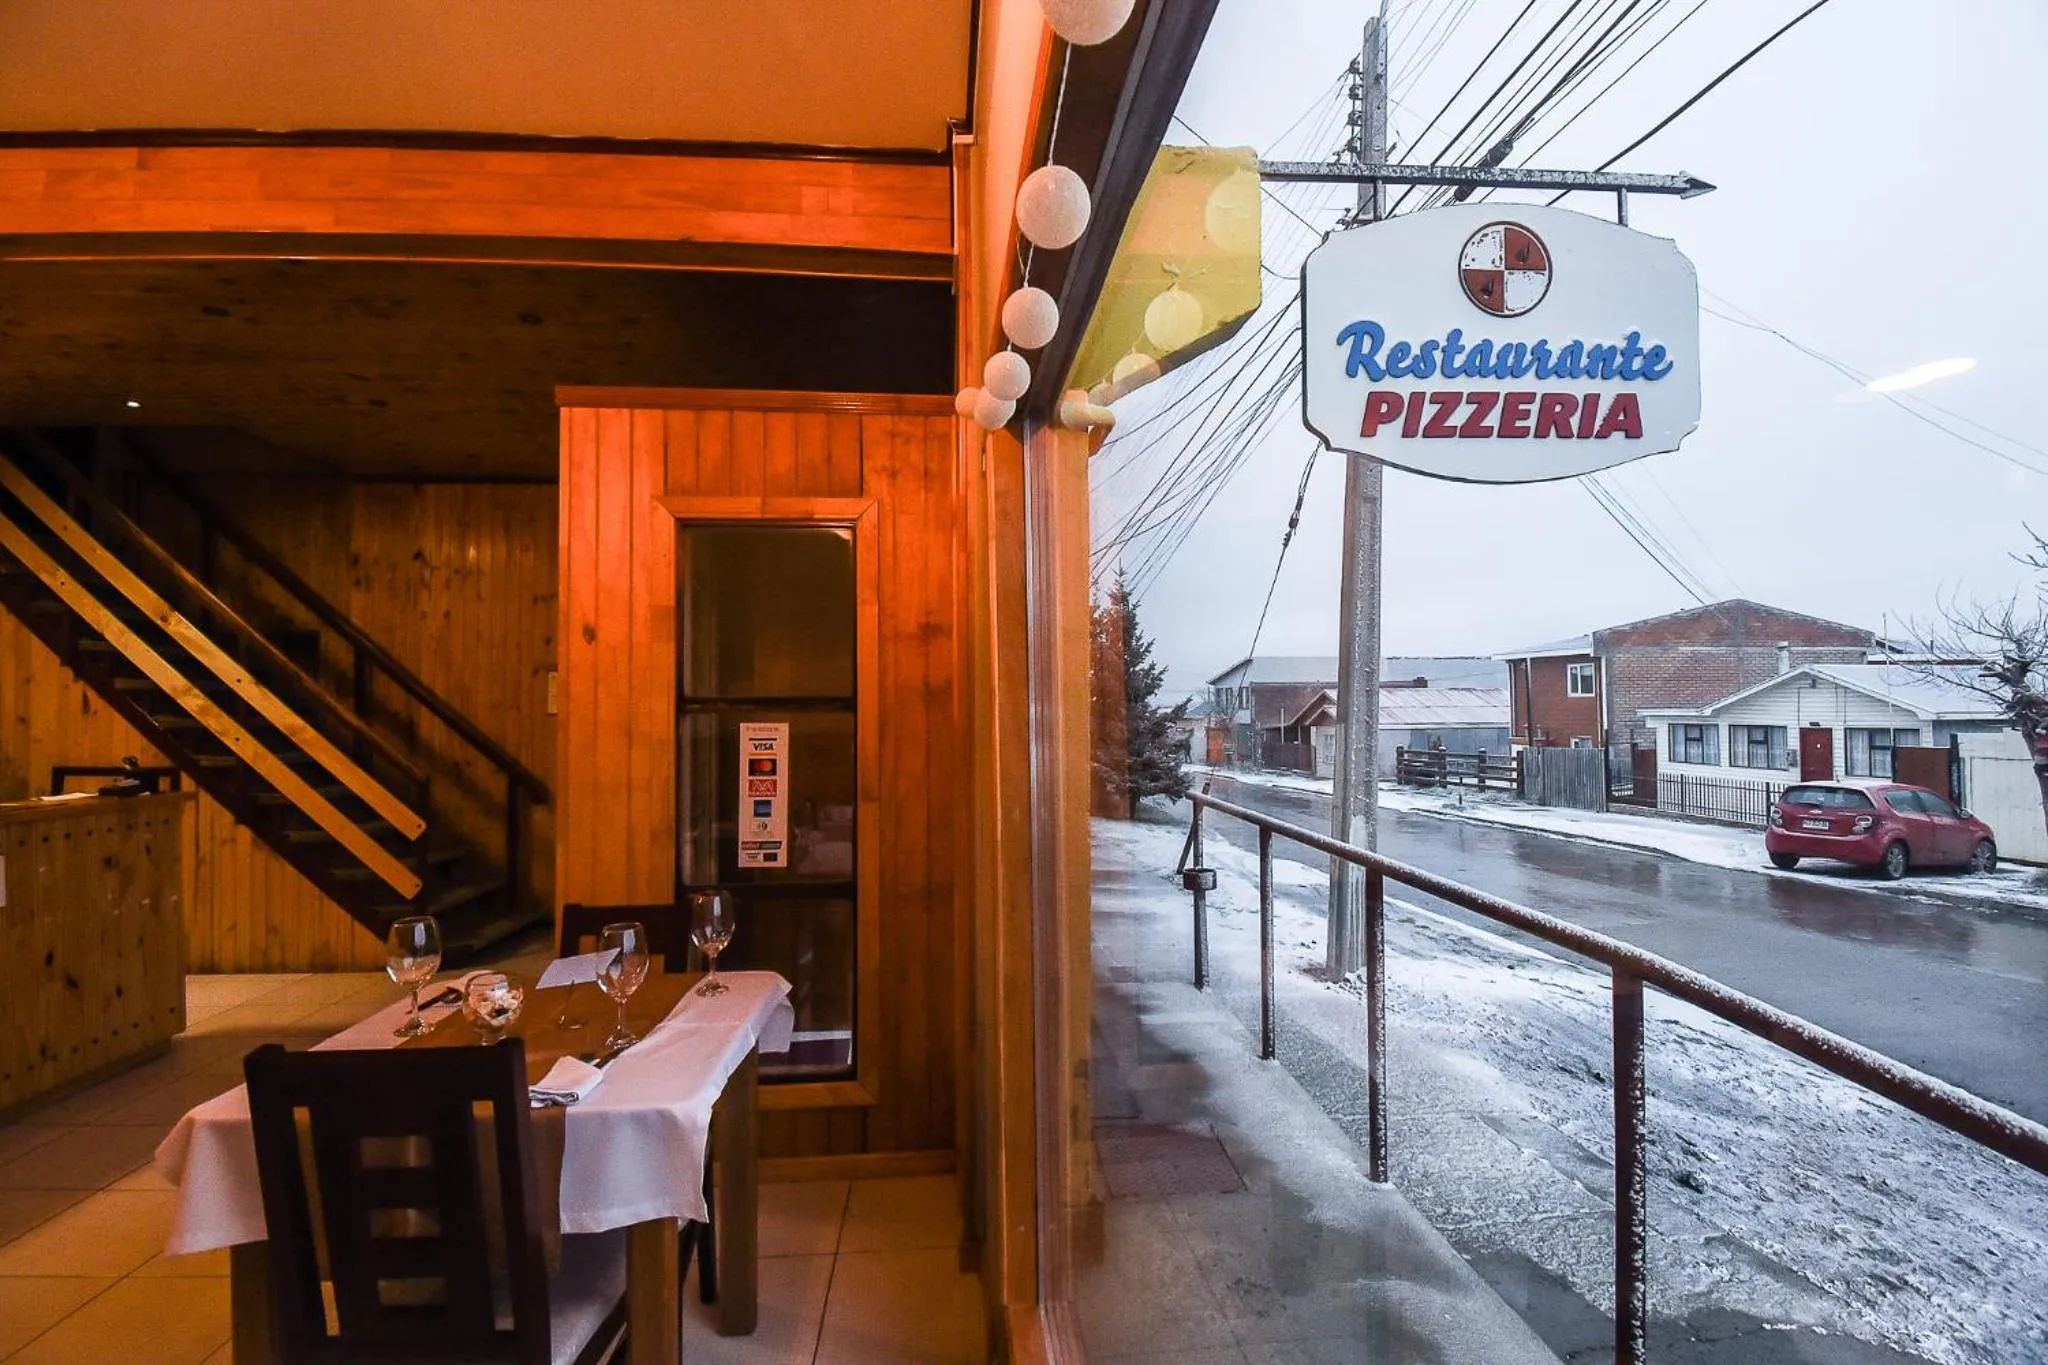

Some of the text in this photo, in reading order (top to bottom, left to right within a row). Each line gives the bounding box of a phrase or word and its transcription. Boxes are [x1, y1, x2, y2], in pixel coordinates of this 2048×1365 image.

[1336, 320, 1674, 382] Restaurante
[1360, 391, 1643, 439] PIZZERIA
[753, 743, 774, 751] VISA
